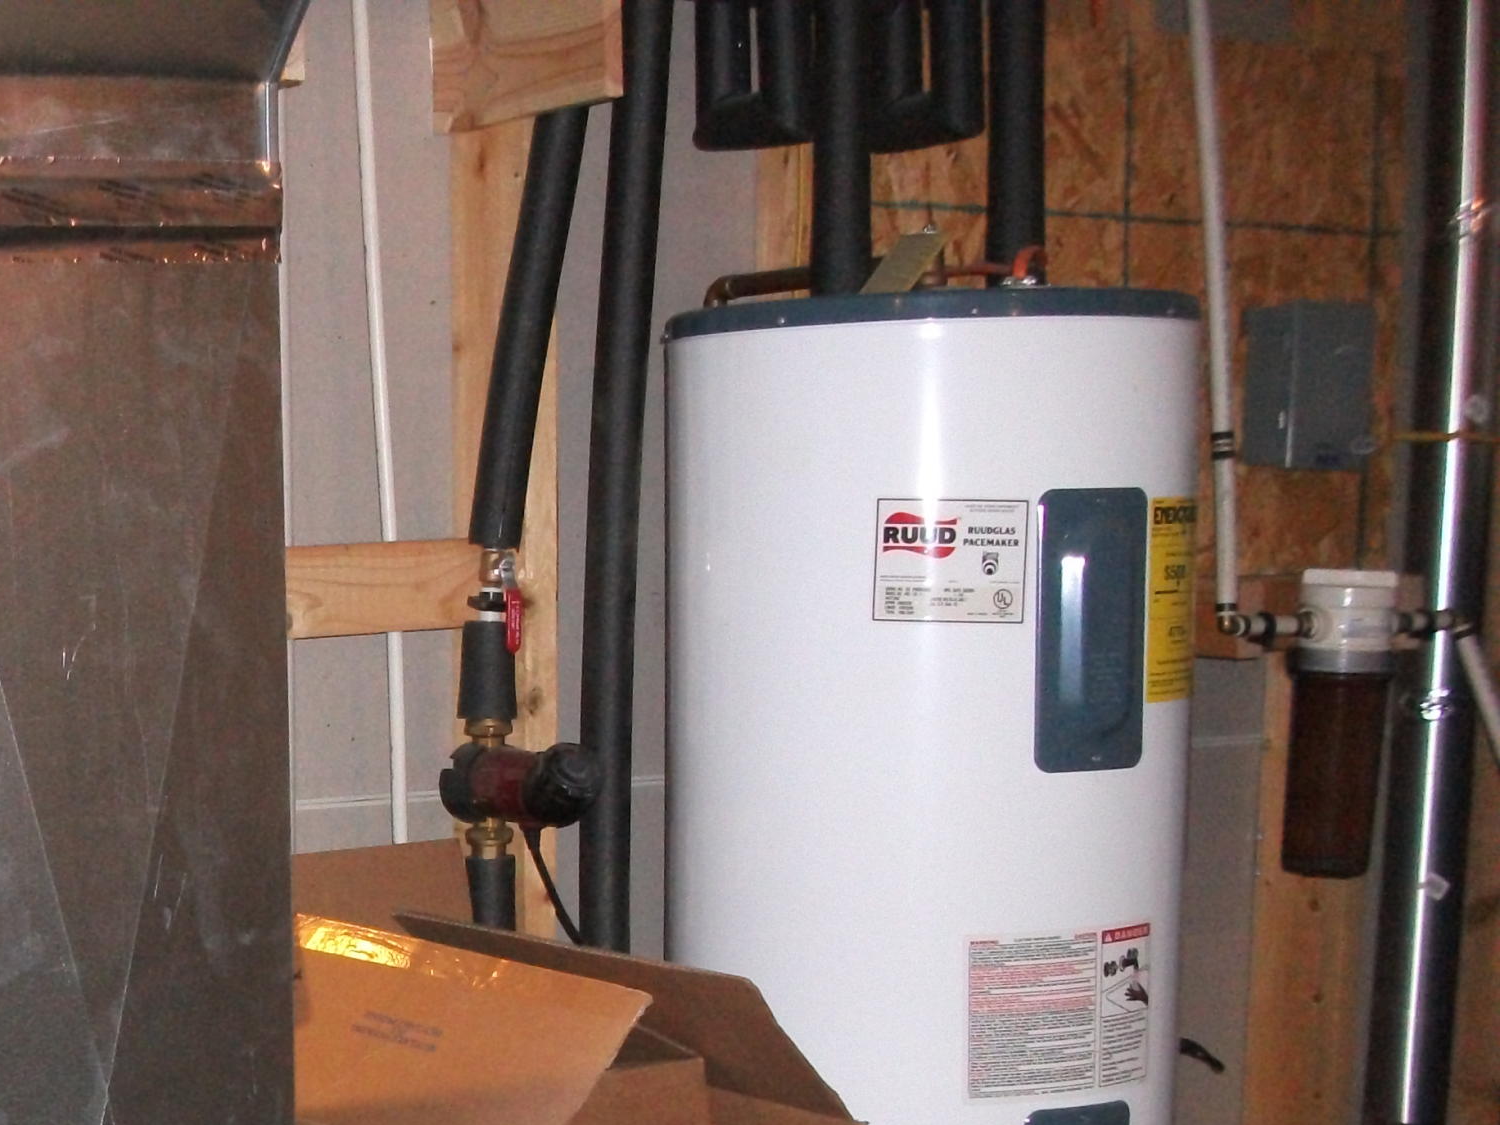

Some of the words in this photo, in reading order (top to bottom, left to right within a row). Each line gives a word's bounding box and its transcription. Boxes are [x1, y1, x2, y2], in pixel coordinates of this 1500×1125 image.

[967, 526, 1016, 535] RUUDGLAS
[883, 526, 957, 545] RUUD
[962, 538, 1020, 547] PACEMAKER
